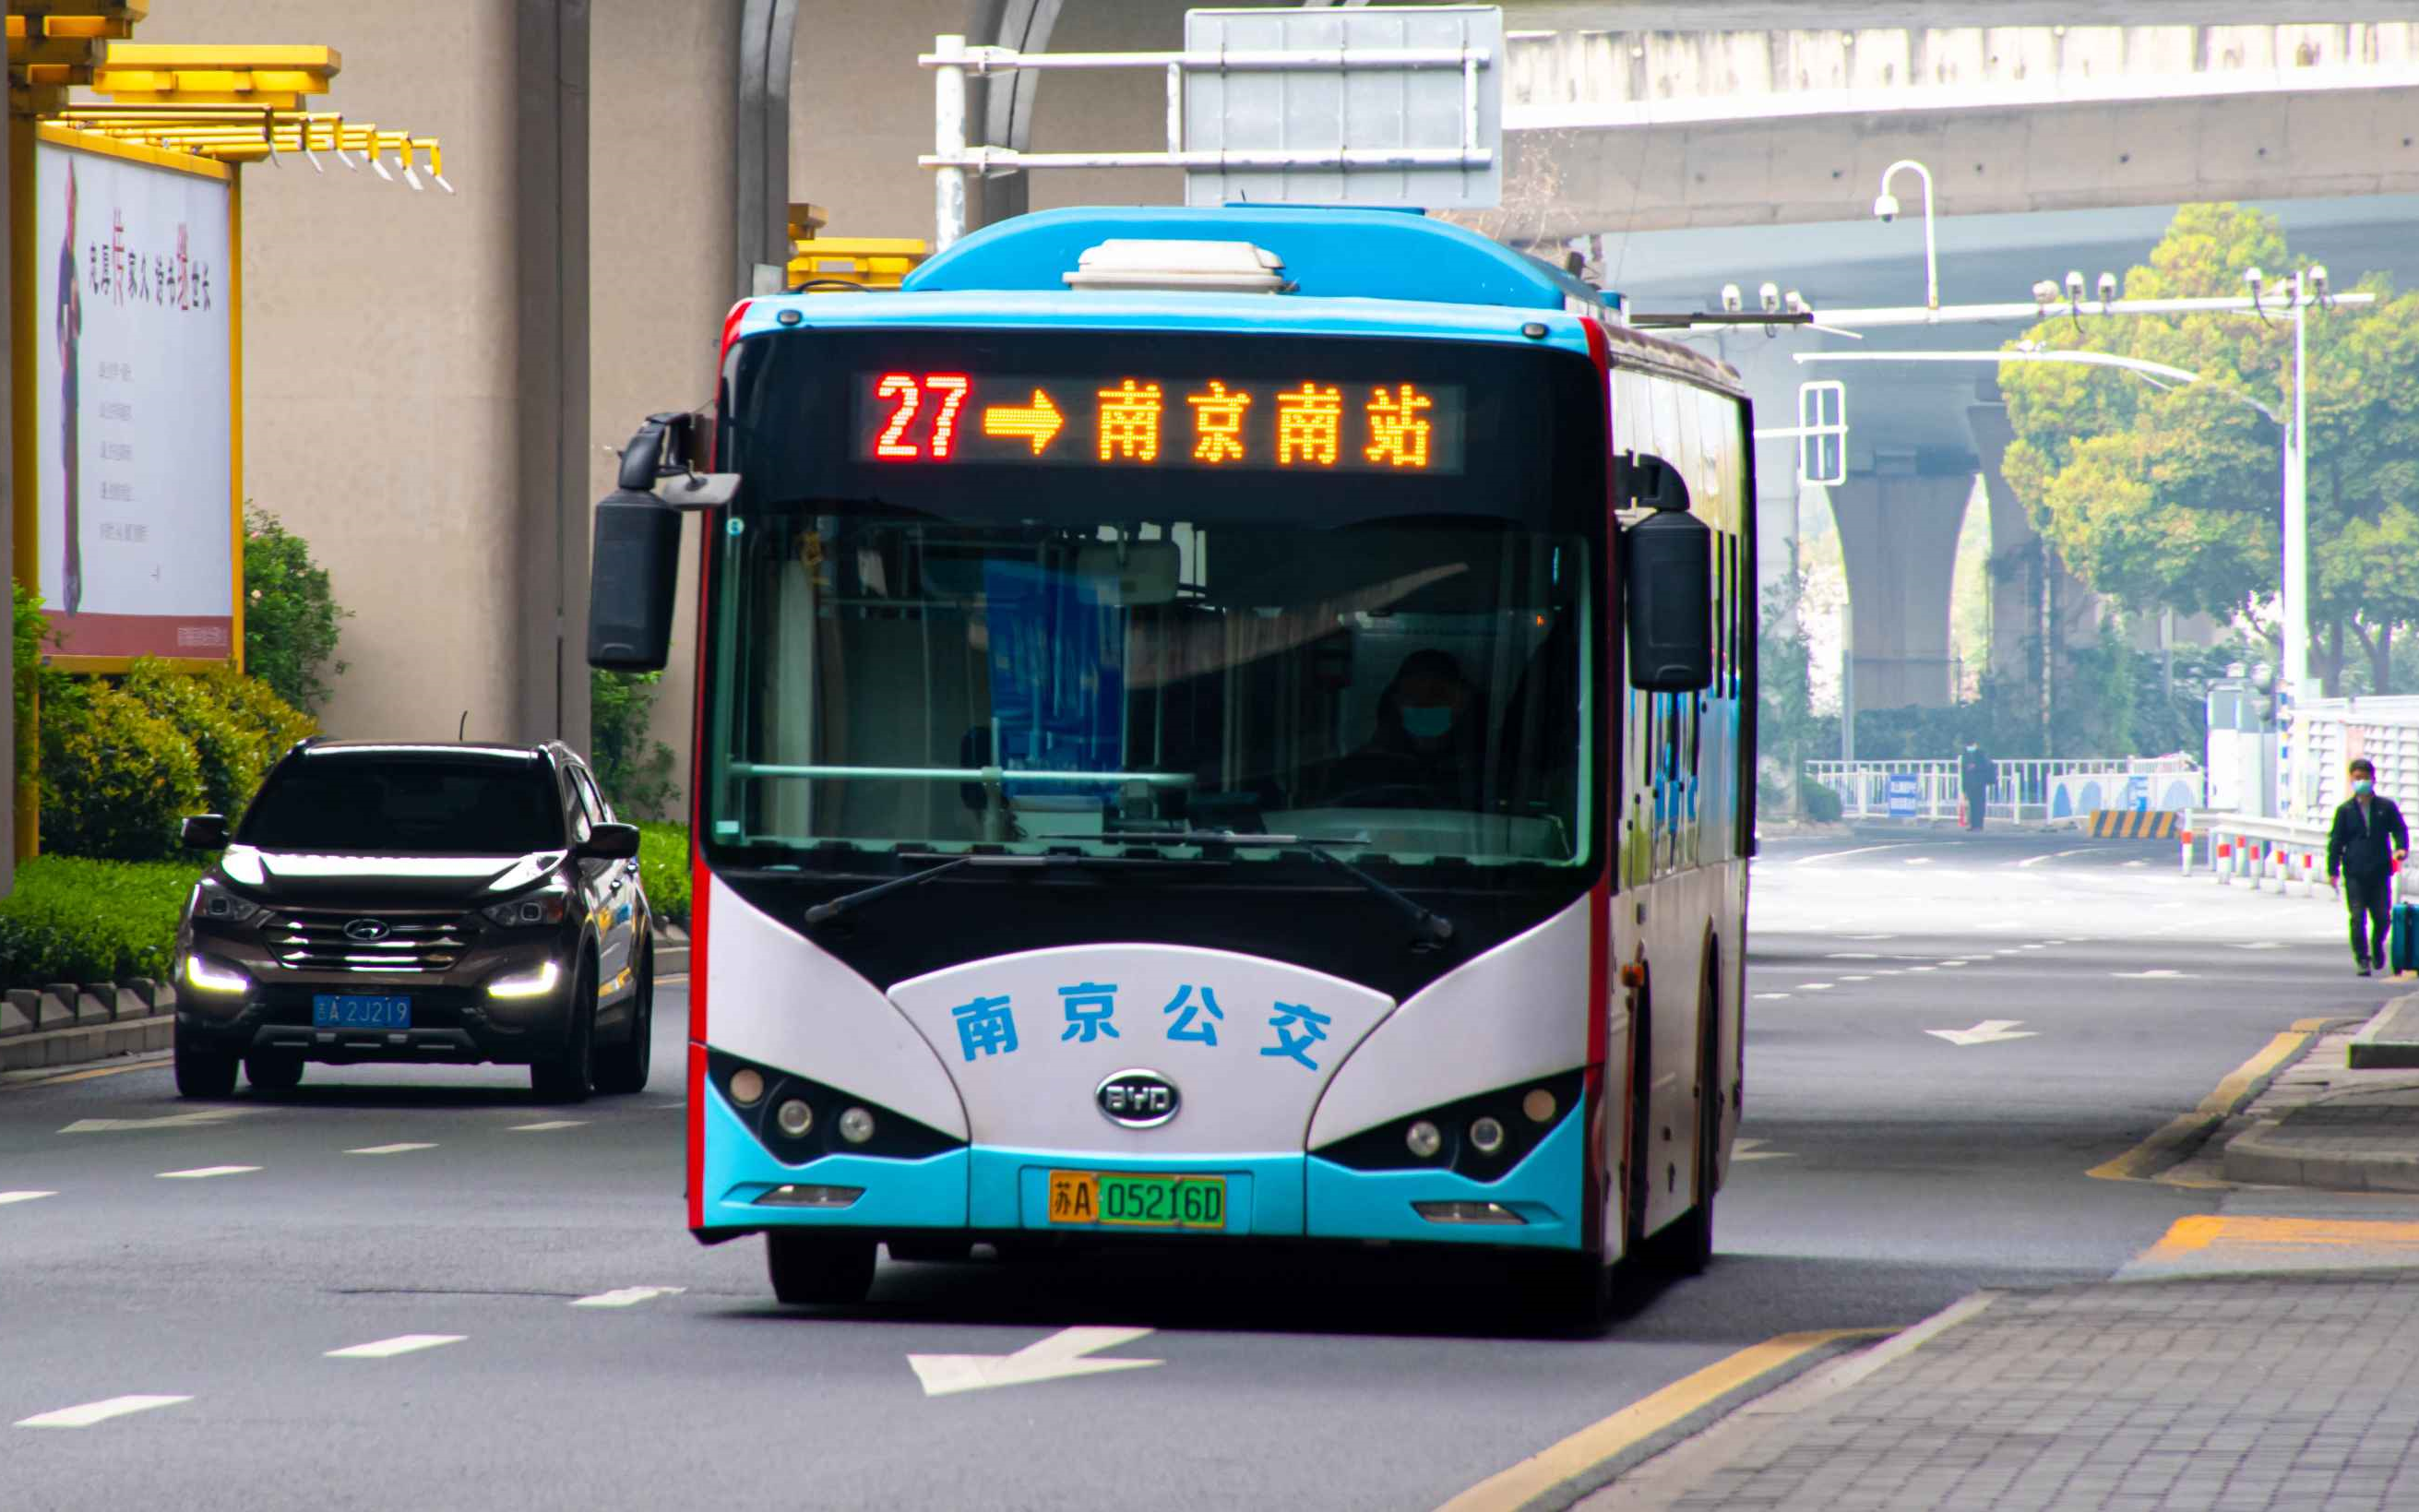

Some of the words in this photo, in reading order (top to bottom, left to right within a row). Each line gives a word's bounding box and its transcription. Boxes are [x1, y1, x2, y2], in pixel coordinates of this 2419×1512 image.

[876, 375, 968, 458] 27
[1098, 379, 1431, 467] 南京南站
[951, 982, 1331, 1070] 南京公交
[1107, 1086, 1168, 1111] BYD
[1107, 1183, 1221, 1221] 05216D
